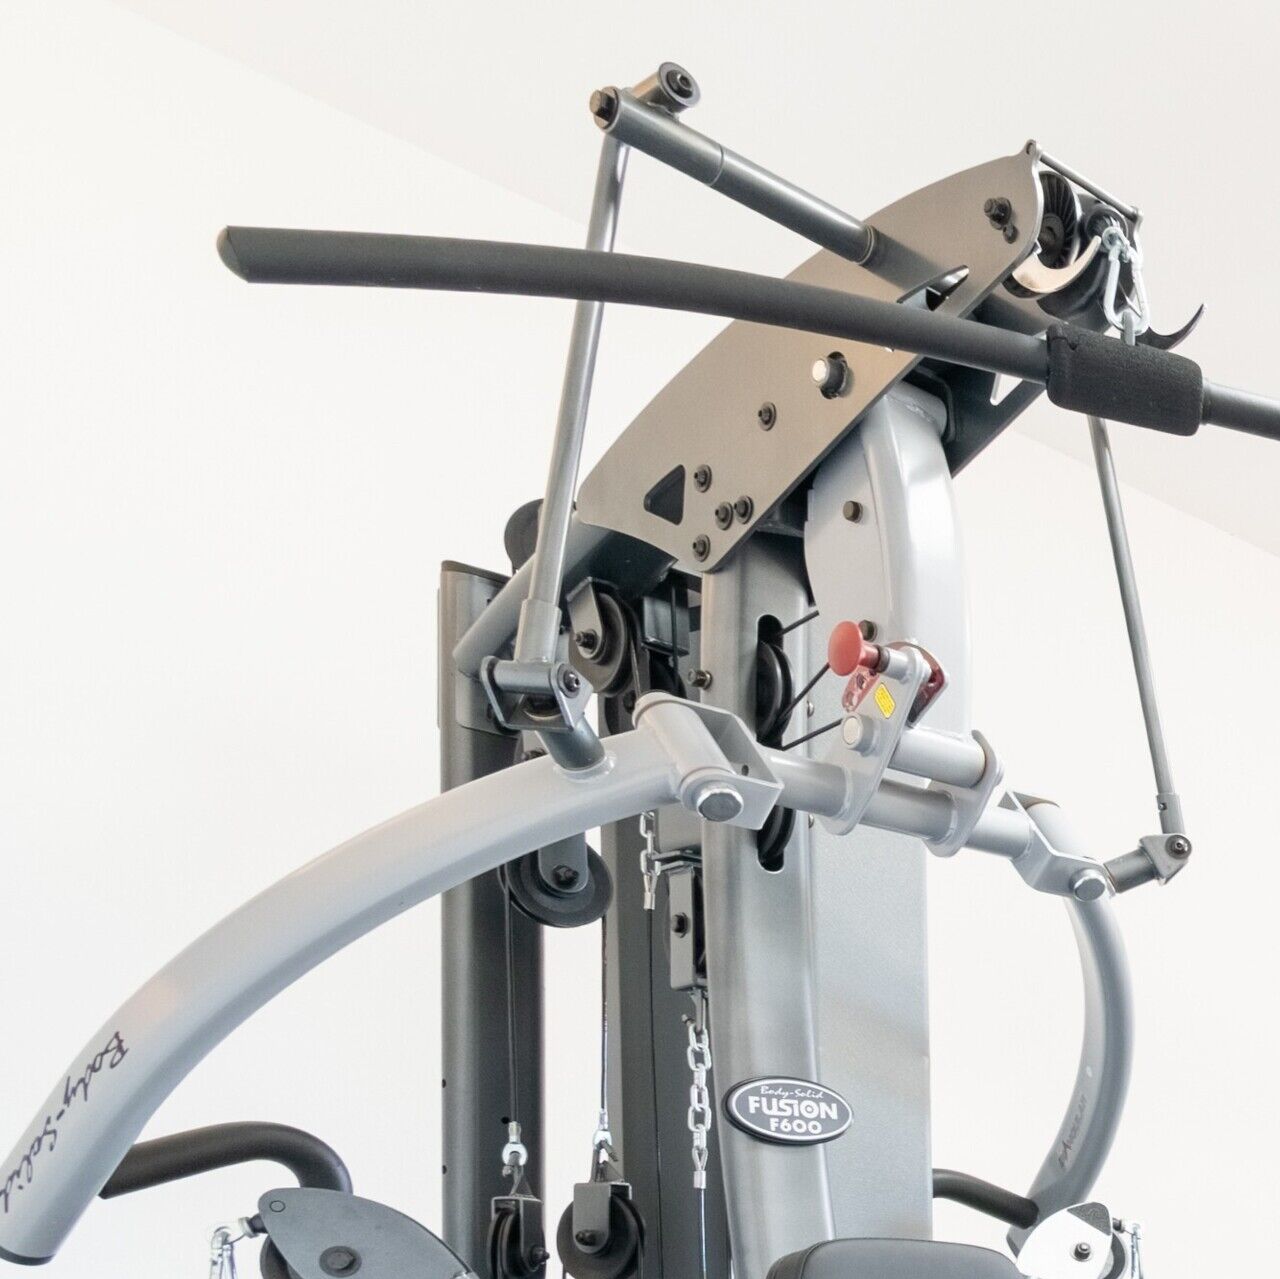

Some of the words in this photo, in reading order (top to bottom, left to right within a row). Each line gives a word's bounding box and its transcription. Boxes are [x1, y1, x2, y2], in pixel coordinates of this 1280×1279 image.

[760, 1085, 824, 1099] Body-Solid
[748, 1096, 839, 1120] FUSION
[769, 1117, 823, 1134] F600
